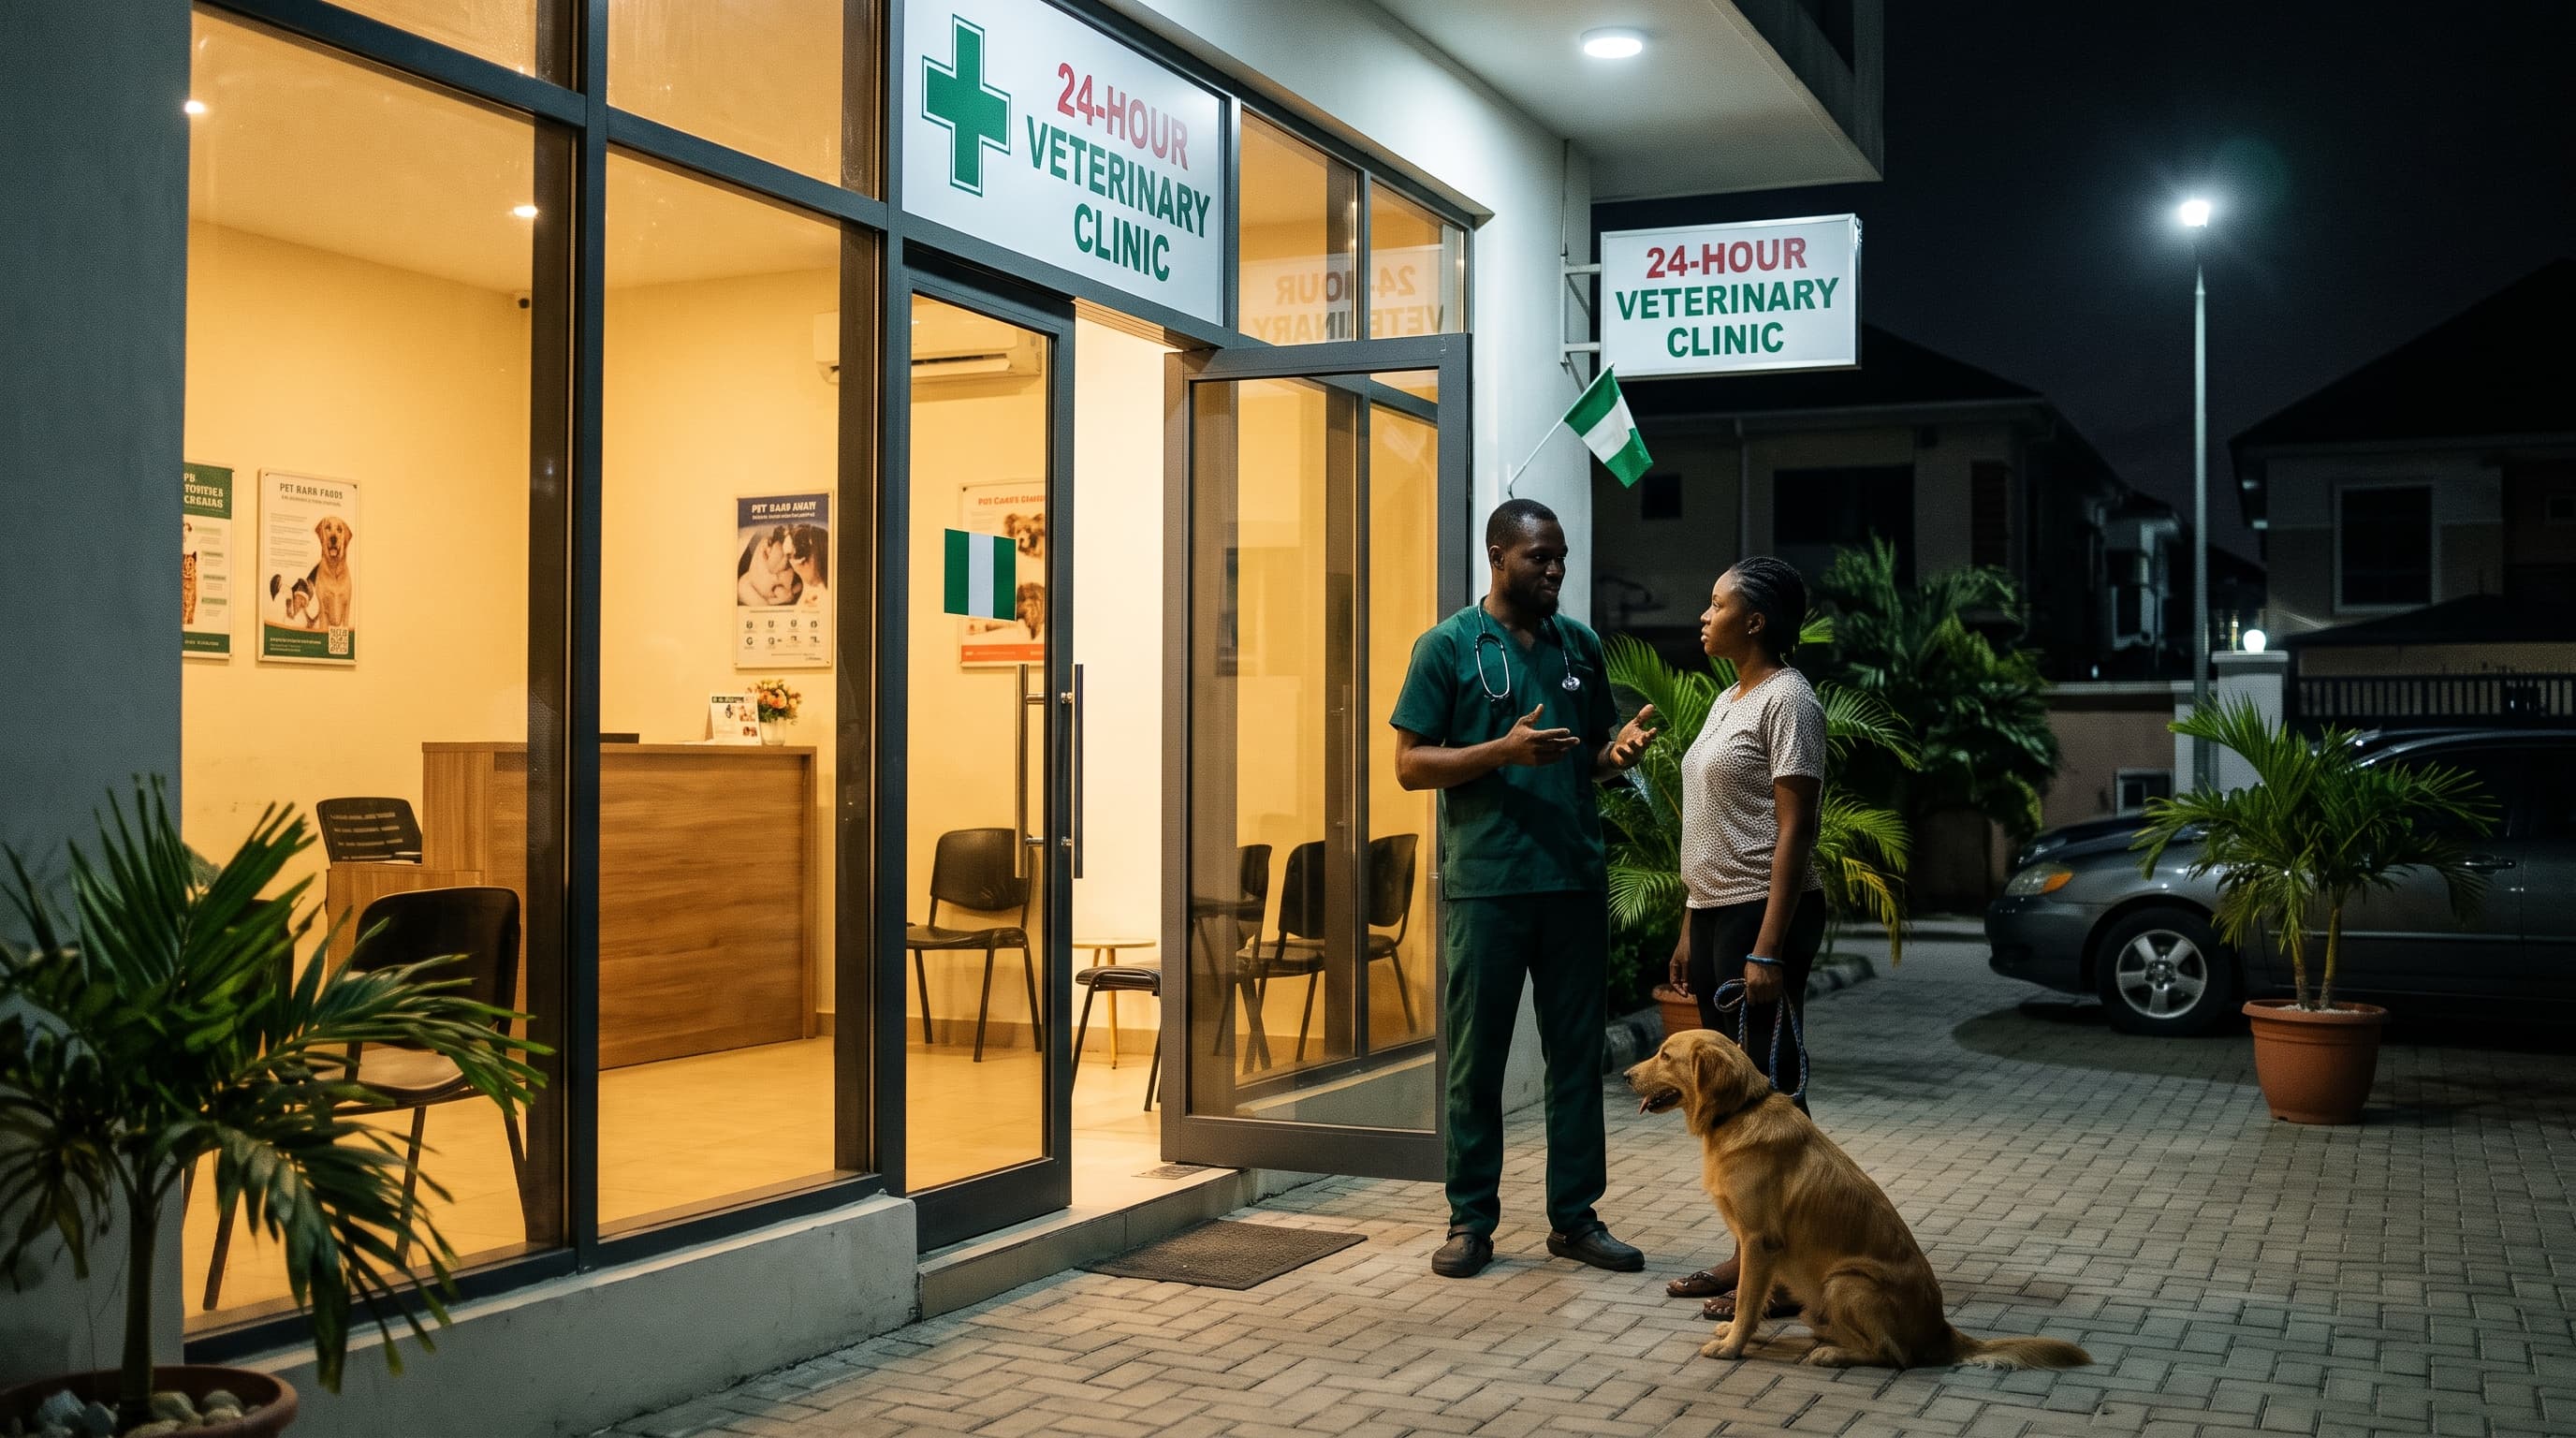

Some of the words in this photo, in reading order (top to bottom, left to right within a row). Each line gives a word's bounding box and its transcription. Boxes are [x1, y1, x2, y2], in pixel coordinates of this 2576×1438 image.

[1058, 63, 1188, 171] 24-HOUR
[1027, 114, 1210, 238] VETERINARY
[1075, 203, 1170, 282] CLINIC
[1647, 238, 1808, 279] 24-HOUR
[1616, 277, 1839, 320] VETERINARY
[1667, 322, 1784, 358] CLINIC
[280, 483, 294, 492] PET
